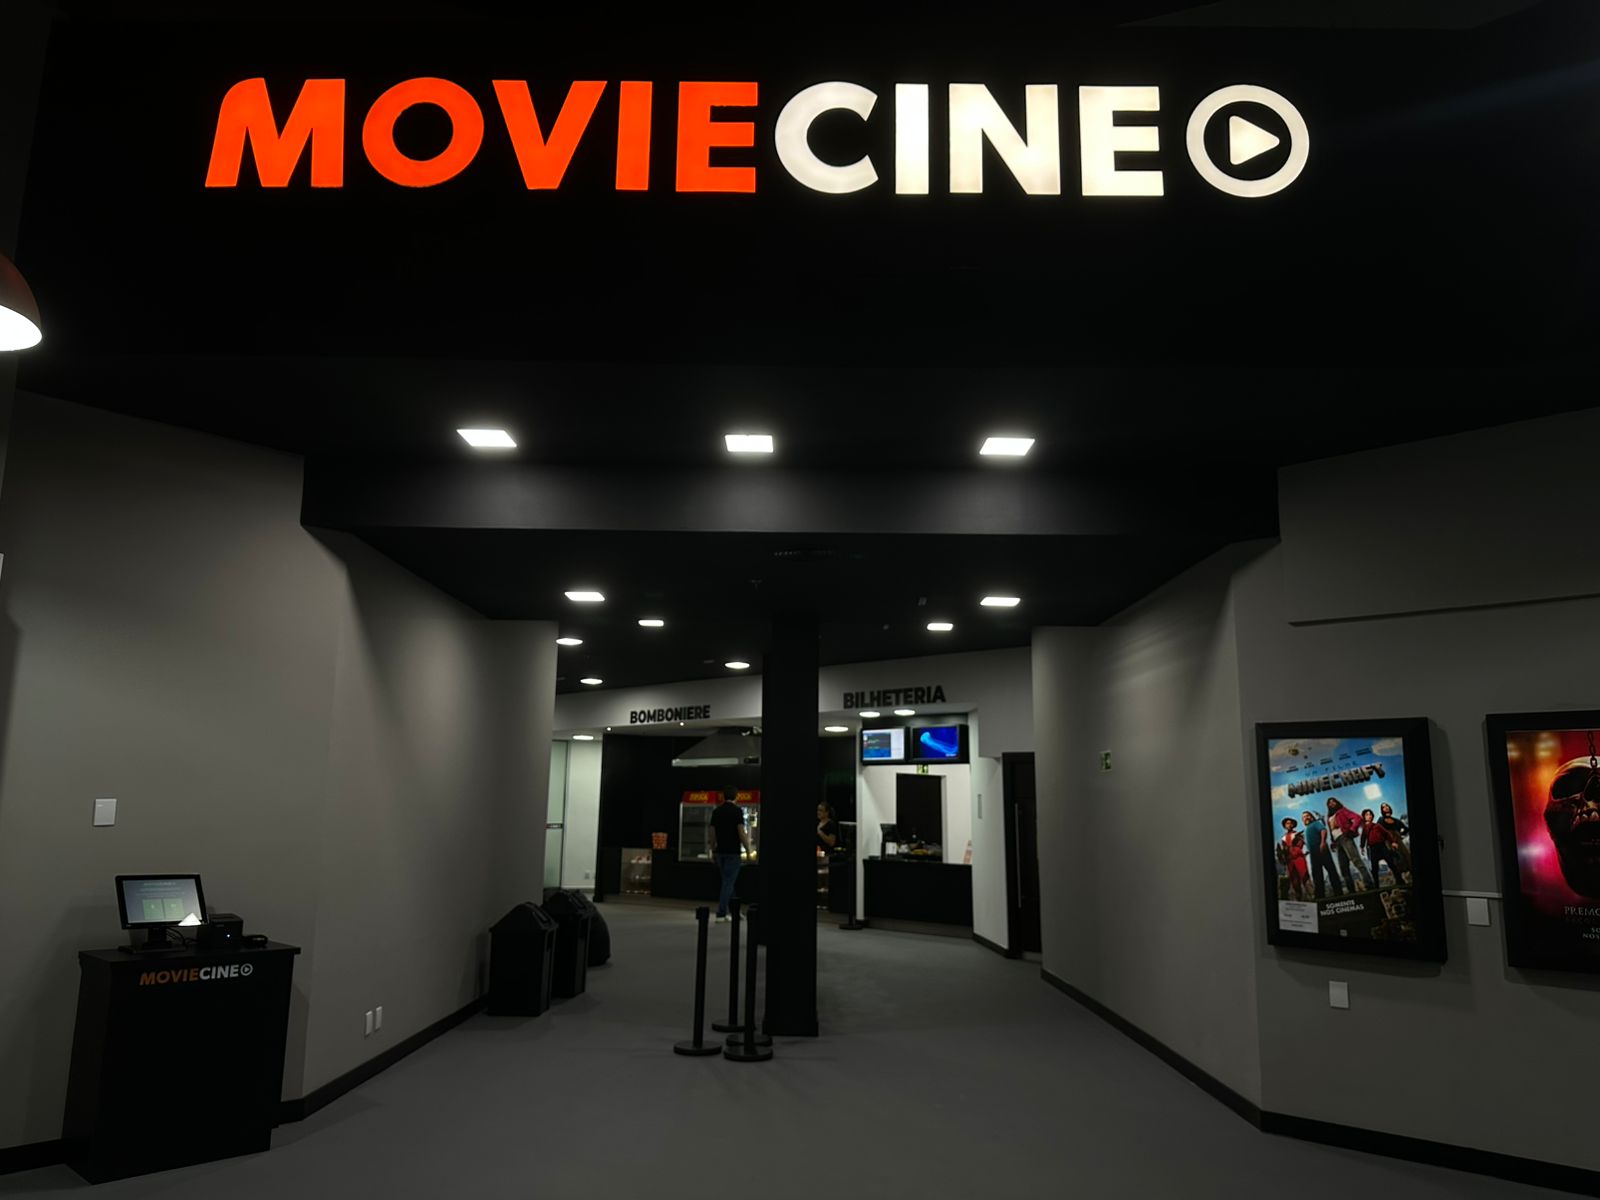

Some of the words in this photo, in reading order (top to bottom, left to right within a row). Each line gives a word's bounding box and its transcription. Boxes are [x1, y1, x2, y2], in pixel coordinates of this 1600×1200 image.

[843, 685, 946, 709] BILHETERIA
[630, 705, 710, 724] BOMBONIERE
[1287, 762, 1385, 798] MINECRAFT
[1320, 909, 1335, 917] NOS
[1335, 904, 1365, 914] CINEMAS
[1325, 899, 1356, 909] SOMENTE
[139, 964, 240, 986] MOVIECINE
